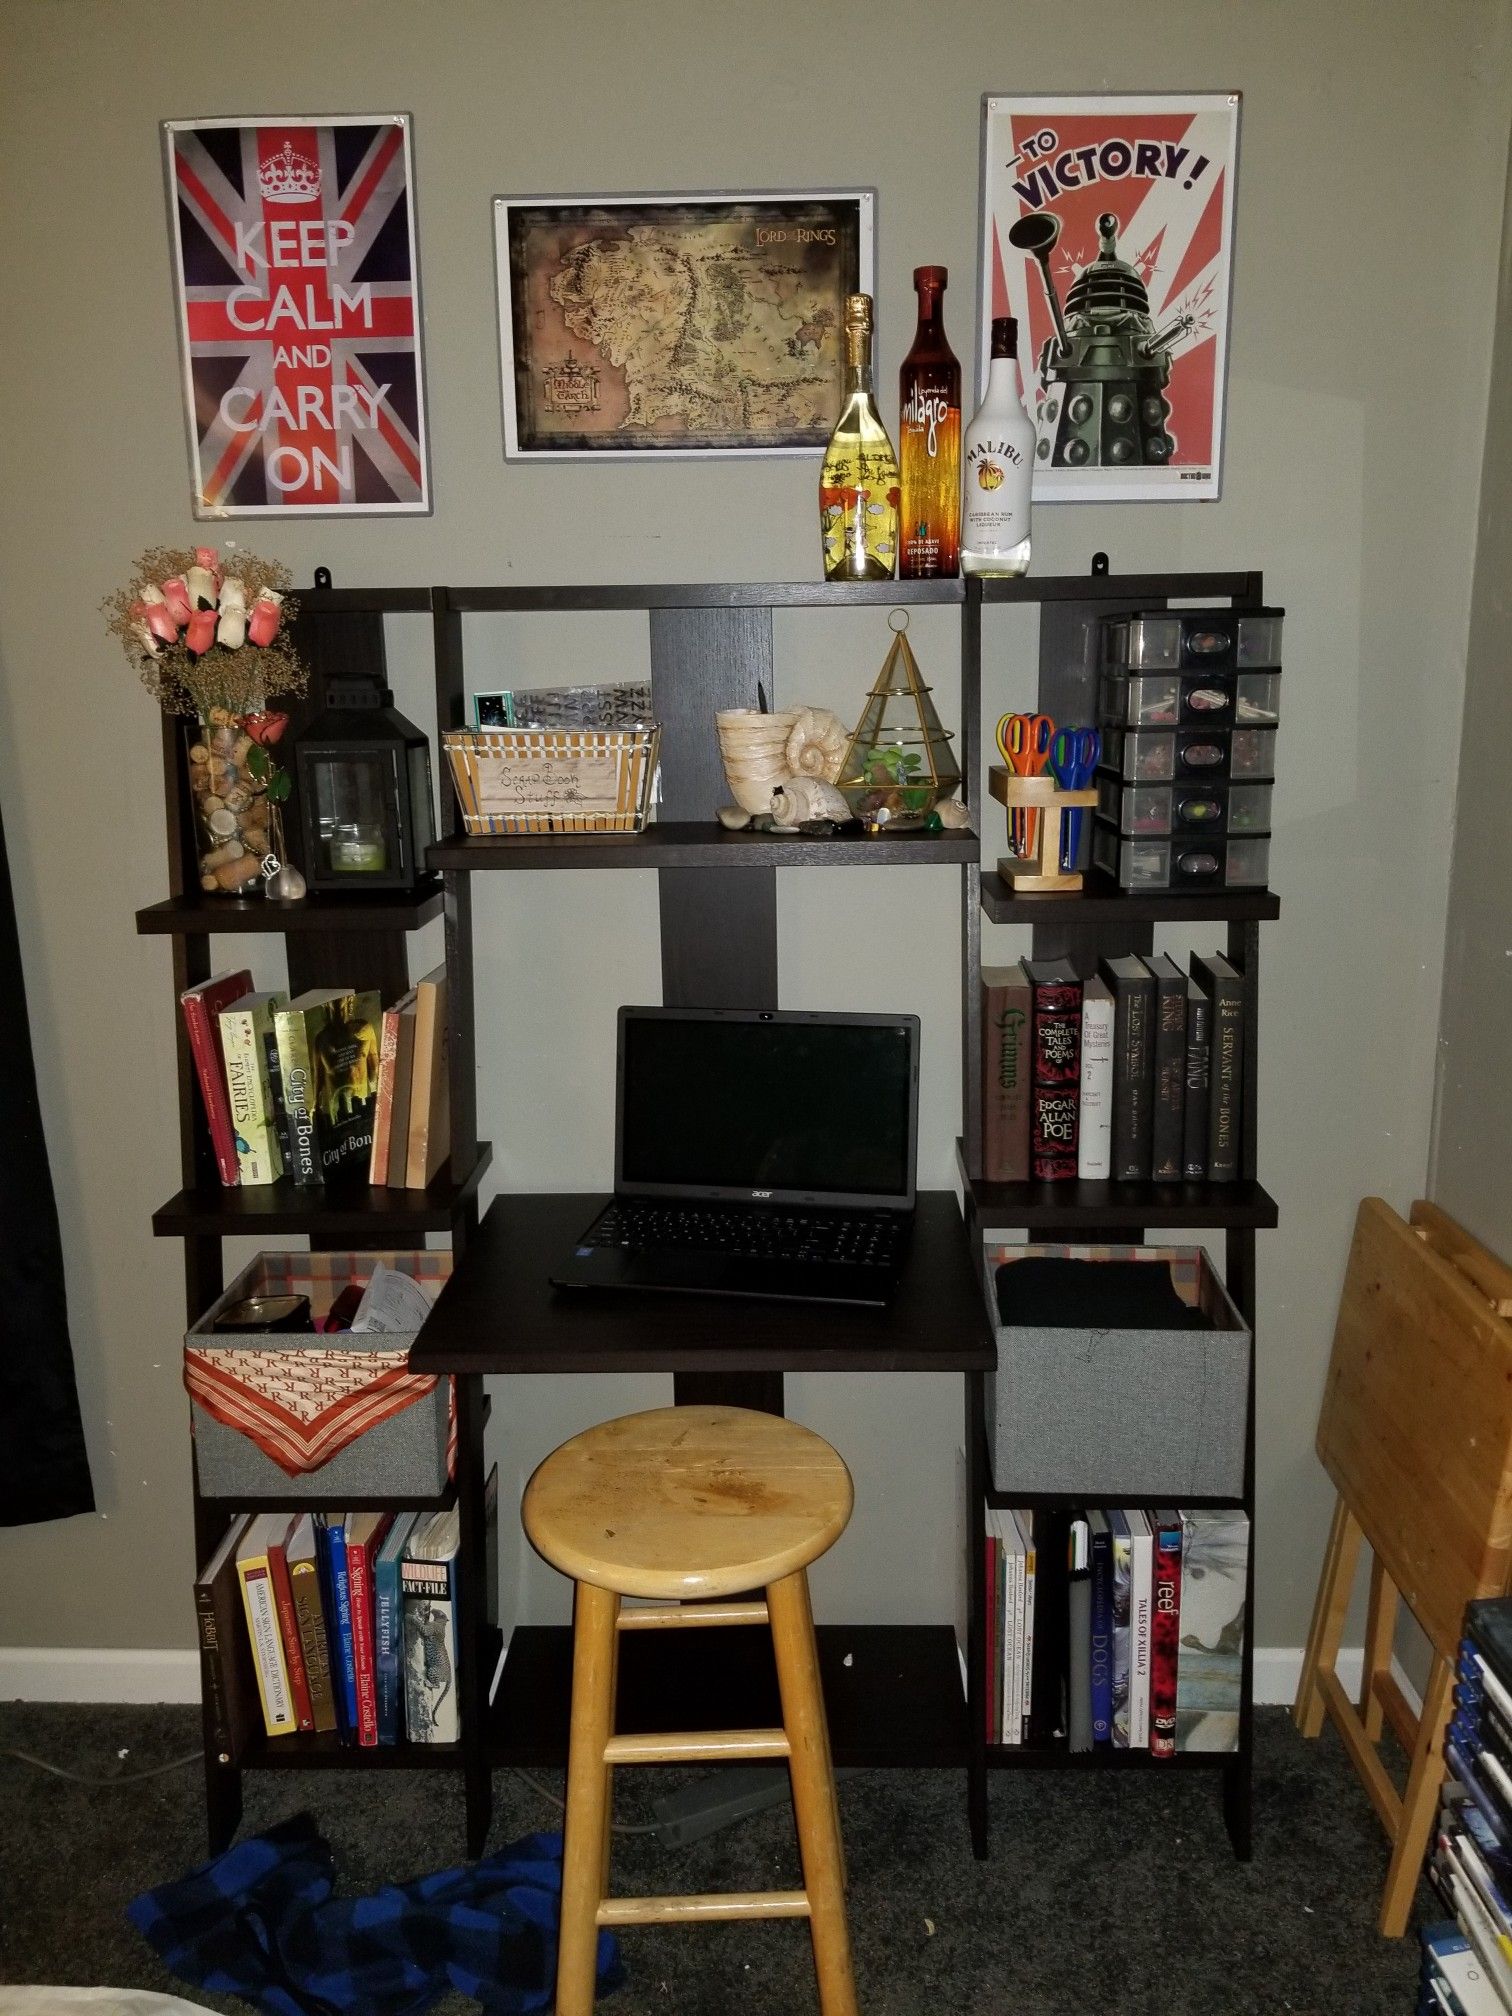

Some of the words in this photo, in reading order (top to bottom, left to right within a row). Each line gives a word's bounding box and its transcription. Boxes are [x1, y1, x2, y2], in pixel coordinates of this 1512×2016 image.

[1021, 131, 1057, 161] TO
[1012, 141, 1210, 210] VICTORY!
[234, 219, 355, 269] KEEP
[756, 228, 787, 246] LORD
[796, 229, 836, 246] RINGS
[225, 282, 373, 331] CALM
[273, 345, 331, 369] AND
[219, 383, 392, 432] CARRY
[903, 379, 948, 458] milagro
[266, 445, 352, 491] ON
[968, 441, 1024, 467] MALIBU
[1162, 995, 1175, 1032] KING
[1219, 999, 1242, 1007] Anne
[1039, 1028, 1078, 1036] COMPLETE
[1046, 1037, 1072, 1045] TALES
[1045, 1050, 1074, 1060] POEMS
[1221, 1027, 1234, 1081] SERVANT
[288, 1068, 307, 1104] City
[1087, 1071, 1091, 1080] 2
[229, 1061, 250, 1123] FAIRIES
[1039, 1099, 1076, 1111] EDGAR
[294, 1107, 309, 1120] of
[1040, 1112, 1075, 1122] ALLAN
[1218, 1107, 1231, 1148] BONES
[1043, 1122, 1072, 1139] POE
[297, 1125, 313, 1175] Bones
[752, 1190, 773, 1198] acer
[336, 1571, 348, 1600] Religious
[352, 1567, 364, 1597] Signing
[255, 1583, 269, 1617] AMERICAN
[295, 1596, 311, 1626] SIGN
[1138, 1599, 1148, 1625] TALES
[1157, 1581, 1178, 1615] reef
[261, 1617, 271, 1633] SIGN
[281, 1600, 295, 1635] Japanese
[340, 1601, 351, 1625] Signing
[379, 1595, 390, 1655] JELLYFISH
[289, 1636, 298, 1655] Step
[311, 1614, 331, 1679] AMERICAN
[342, 1632, 353, 1654] Elaine
[1138, 1626, 1146, 1639] OF
[264, 1633, 278, 1669] LANGUAGE
[290, 1656, 301, 1665] by
[302, 1630, 322, 1700] LANGUAGE
[1092, 1634, 1108, 1687] DOGS
[1137, 1639, 1146, 1668] XILLIA
[292, 1667, 302, 1685] Step
[345, 1655, 355, 1683] Costello
[271, 1669, 285, 1709] DICTIONARY
[359, 1673, 370, 1698] Elaine
[362, 1699, 372, 1732] Costello
